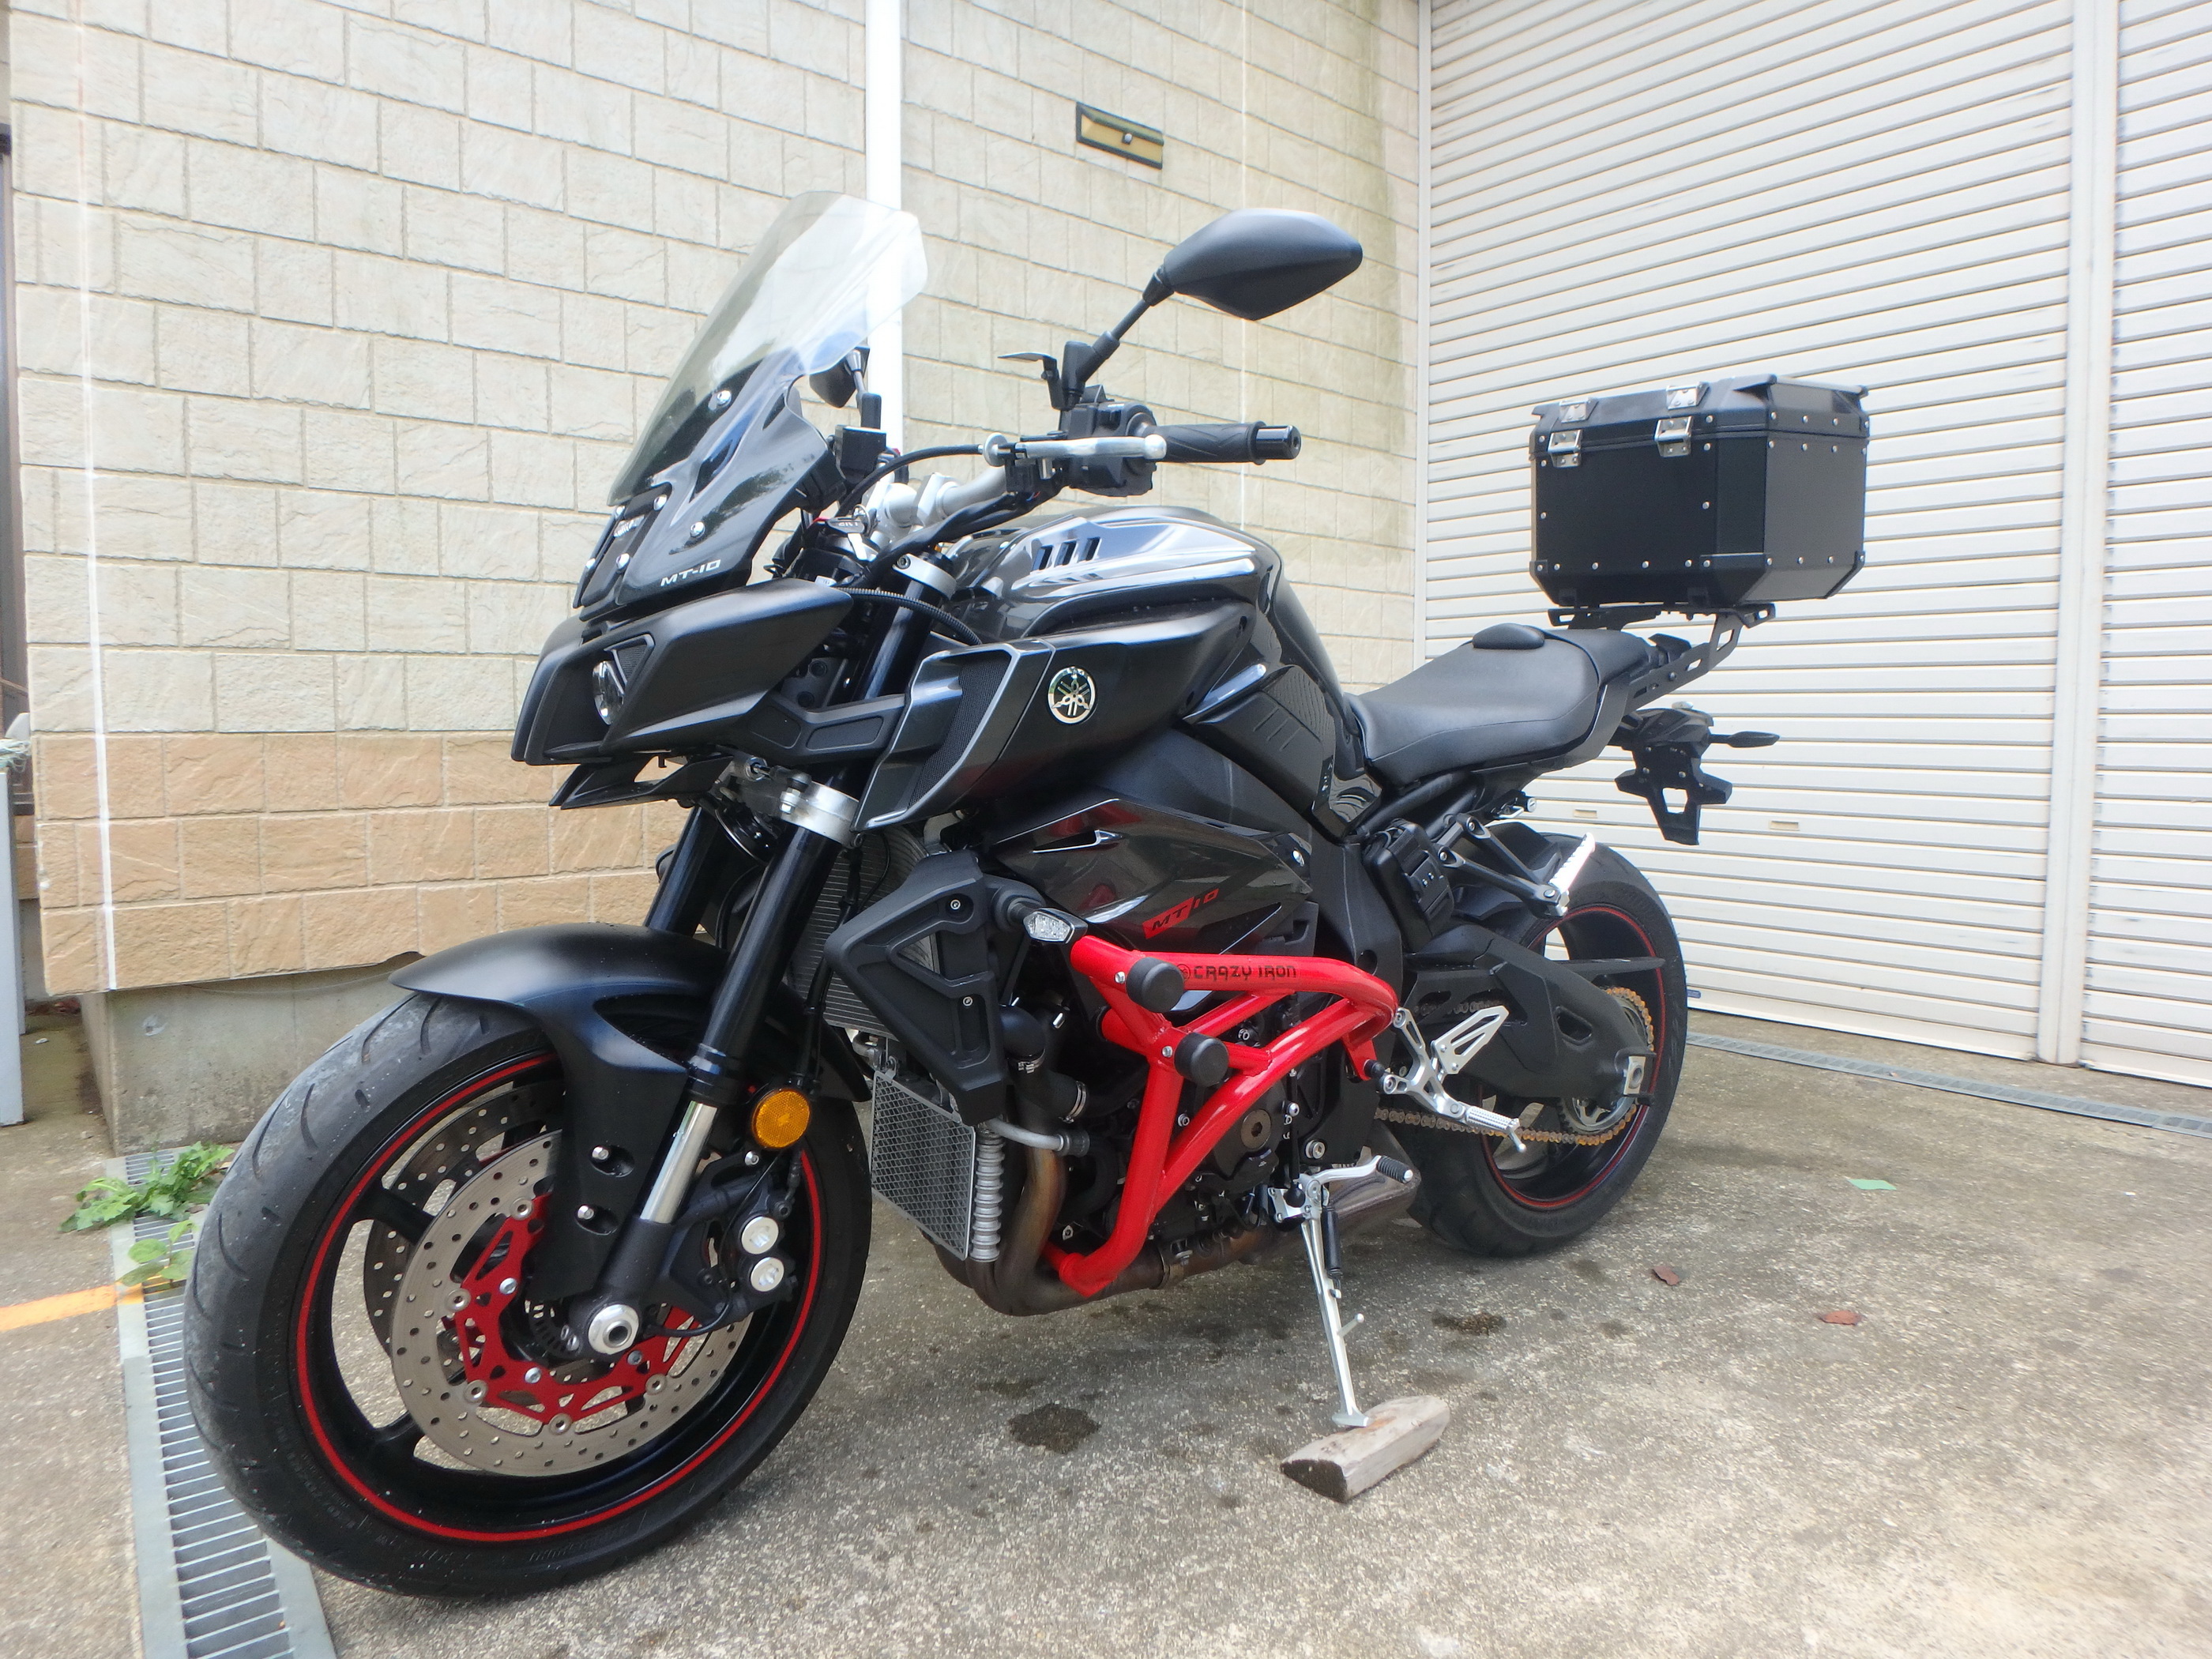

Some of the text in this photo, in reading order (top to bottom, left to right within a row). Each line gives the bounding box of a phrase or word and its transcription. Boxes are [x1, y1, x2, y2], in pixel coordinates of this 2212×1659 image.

[660, 559, 721, 586] MT-10
[1194, 965, 1297, 981] CRAZY IRON
